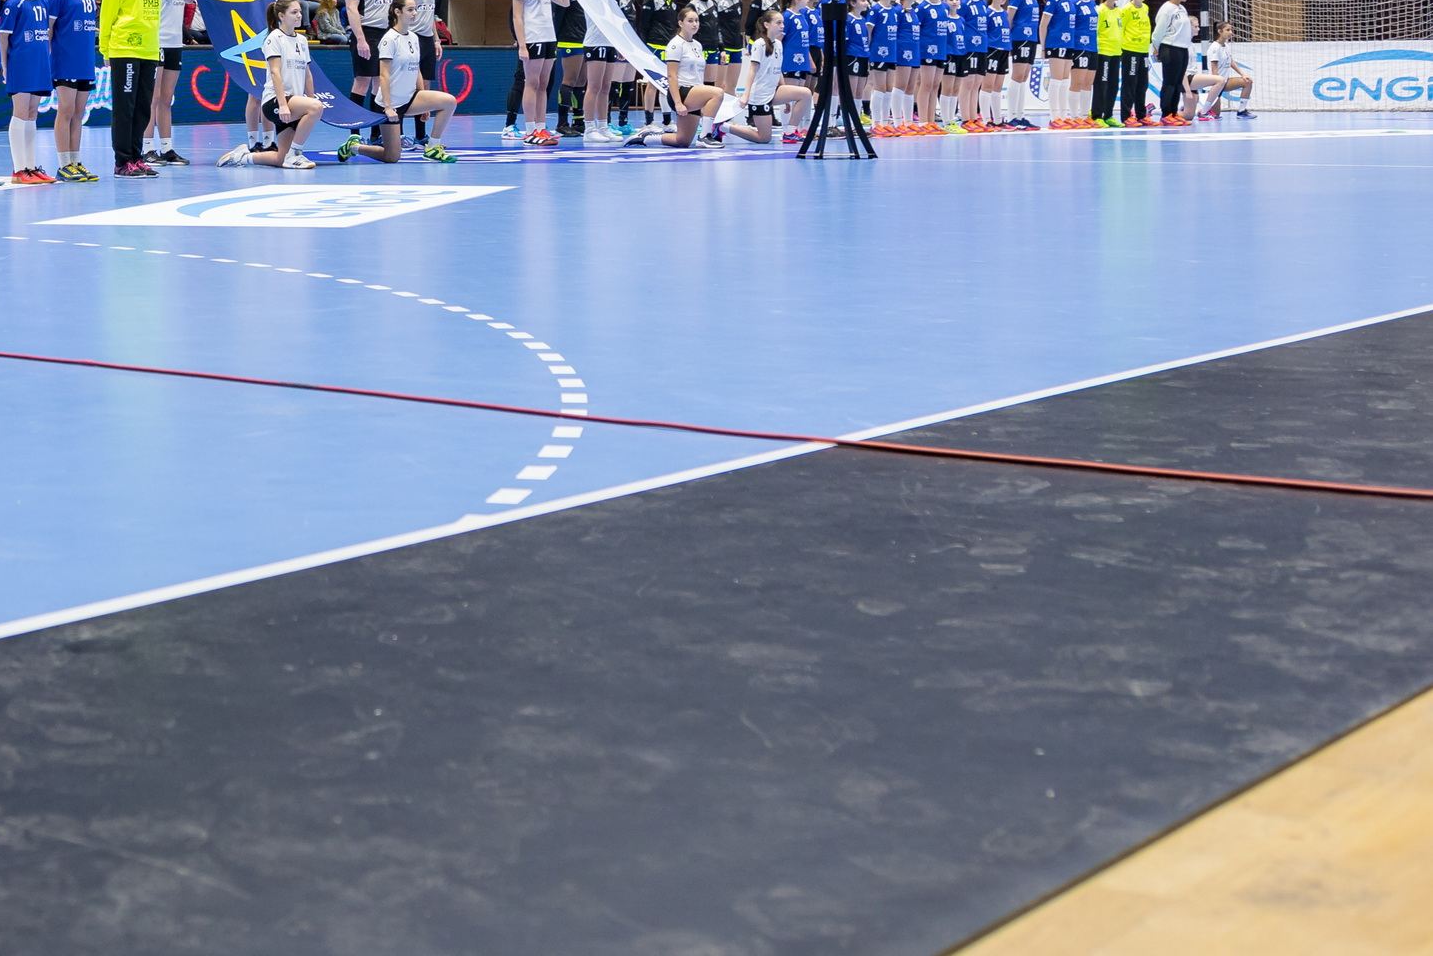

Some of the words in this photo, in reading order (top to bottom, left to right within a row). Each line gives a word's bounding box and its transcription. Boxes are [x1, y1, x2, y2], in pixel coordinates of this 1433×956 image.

[33, 5, 43, 22] 17
[970, 4, 979, 16] 11
[1131, 10, 1141, 20] 12
[794, 18, 803, 30] 2
[882, 12, 889, 24] 7
[993, 16, 1003, 27] 14
[1103, 19, 1109, 29] 1
[296, 44, 301, 54] 4
[407, 41, 415, 54] 8
[535, 43, 542, 56] 7
[598, 47, 607, 59] 17
[1058, 48, 1067, 57] 17
[970, 57, 978, 69] 11
[988, 59, 998, 71] 14
[1129, 56, 1137, 76] Kempa
[124, 63, 134, 92] Kempa
